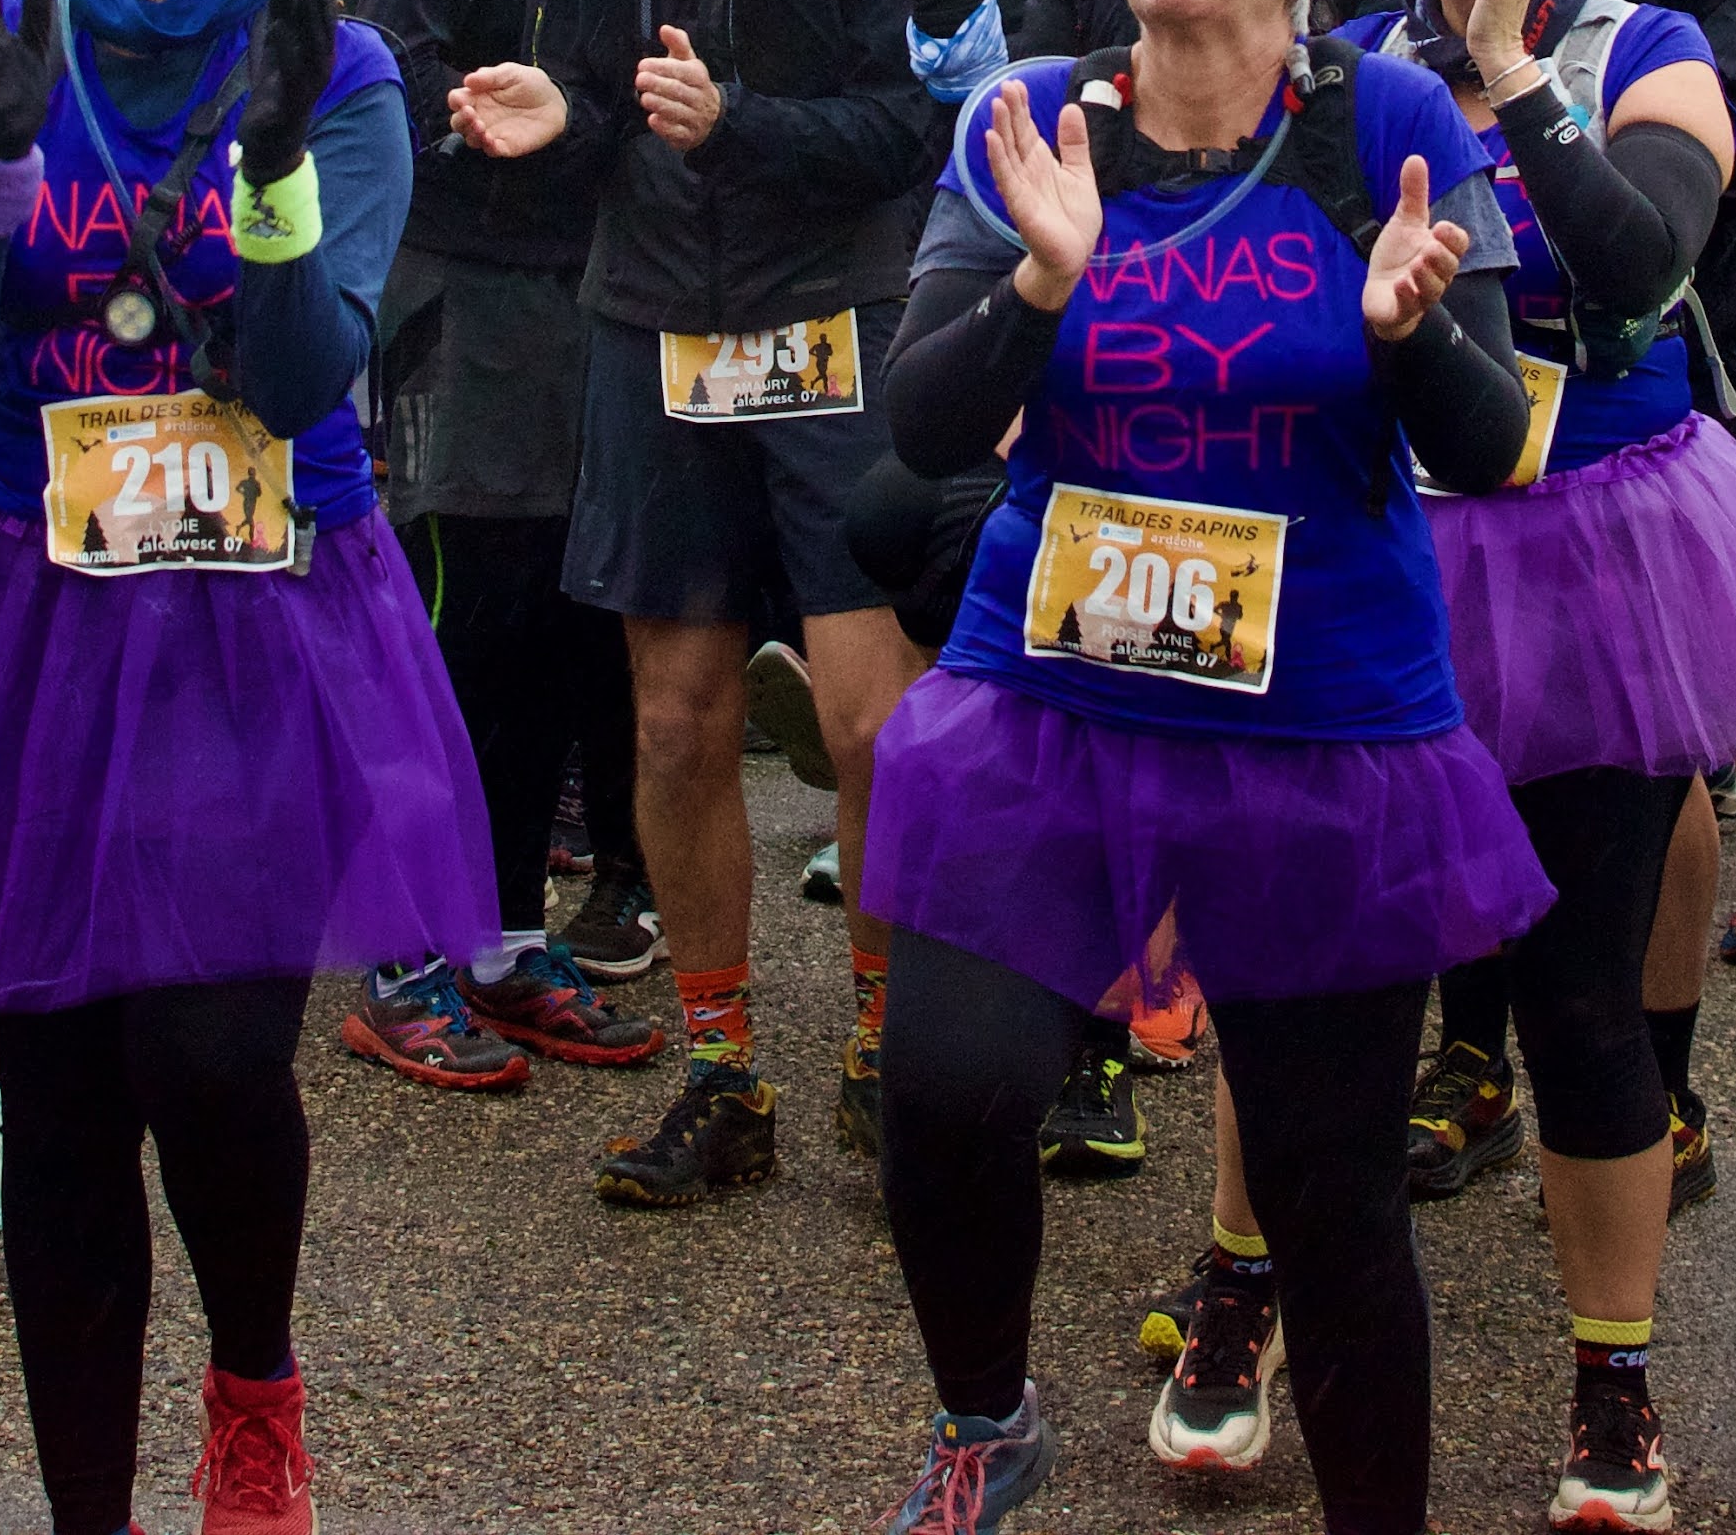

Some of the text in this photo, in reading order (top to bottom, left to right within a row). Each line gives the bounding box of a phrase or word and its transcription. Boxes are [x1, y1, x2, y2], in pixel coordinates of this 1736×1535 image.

[707, 322, 810, 379] 293
[1083, 321, 1275, 393] BY
[78, 409, 136, 430] TRAIL
[141, 402, 182, 422] DES
[730, 393, 795, 409] Lalouvesc
[801, 390, 819, 404] 07
[1053, 403, 1318, 472] NIGHT
[112, 441, 230, 516] 210
[1079, 501, 1260, 541] TRAIL DES SAPINS
[135, 536, 217, 553] Lalouvesc
[223, 537, 244, 552] 07
[1084, 544, 1218, 632] 206
[1101, 623, 1194, 649] ROSELYNE
[1195, 651, 1219, 669] 07
